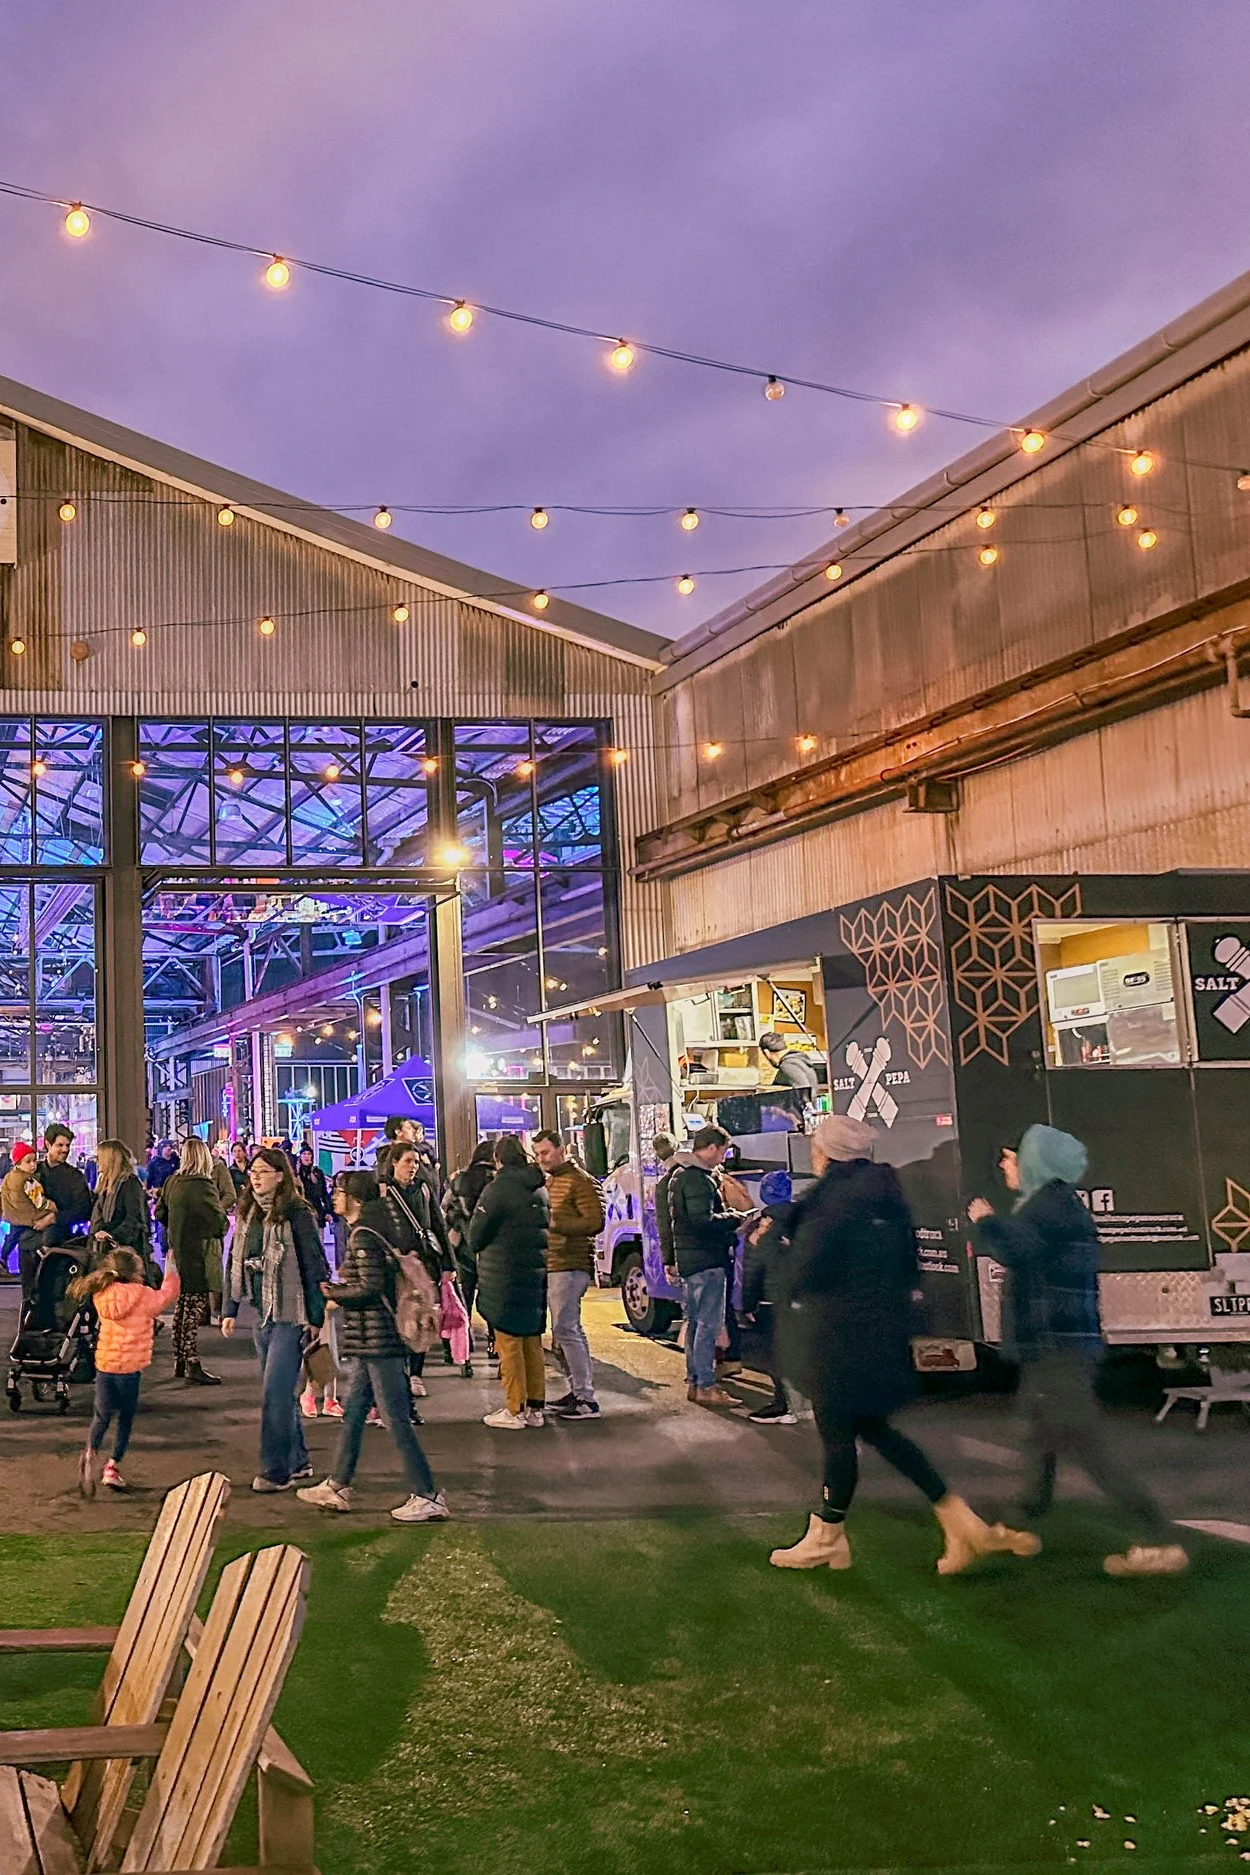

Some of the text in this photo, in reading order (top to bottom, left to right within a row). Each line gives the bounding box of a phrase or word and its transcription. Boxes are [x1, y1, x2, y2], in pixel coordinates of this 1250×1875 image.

[1195, 977, 1239, 991] SALT
[833, 1070, 911, 1091] SALT PEPA
